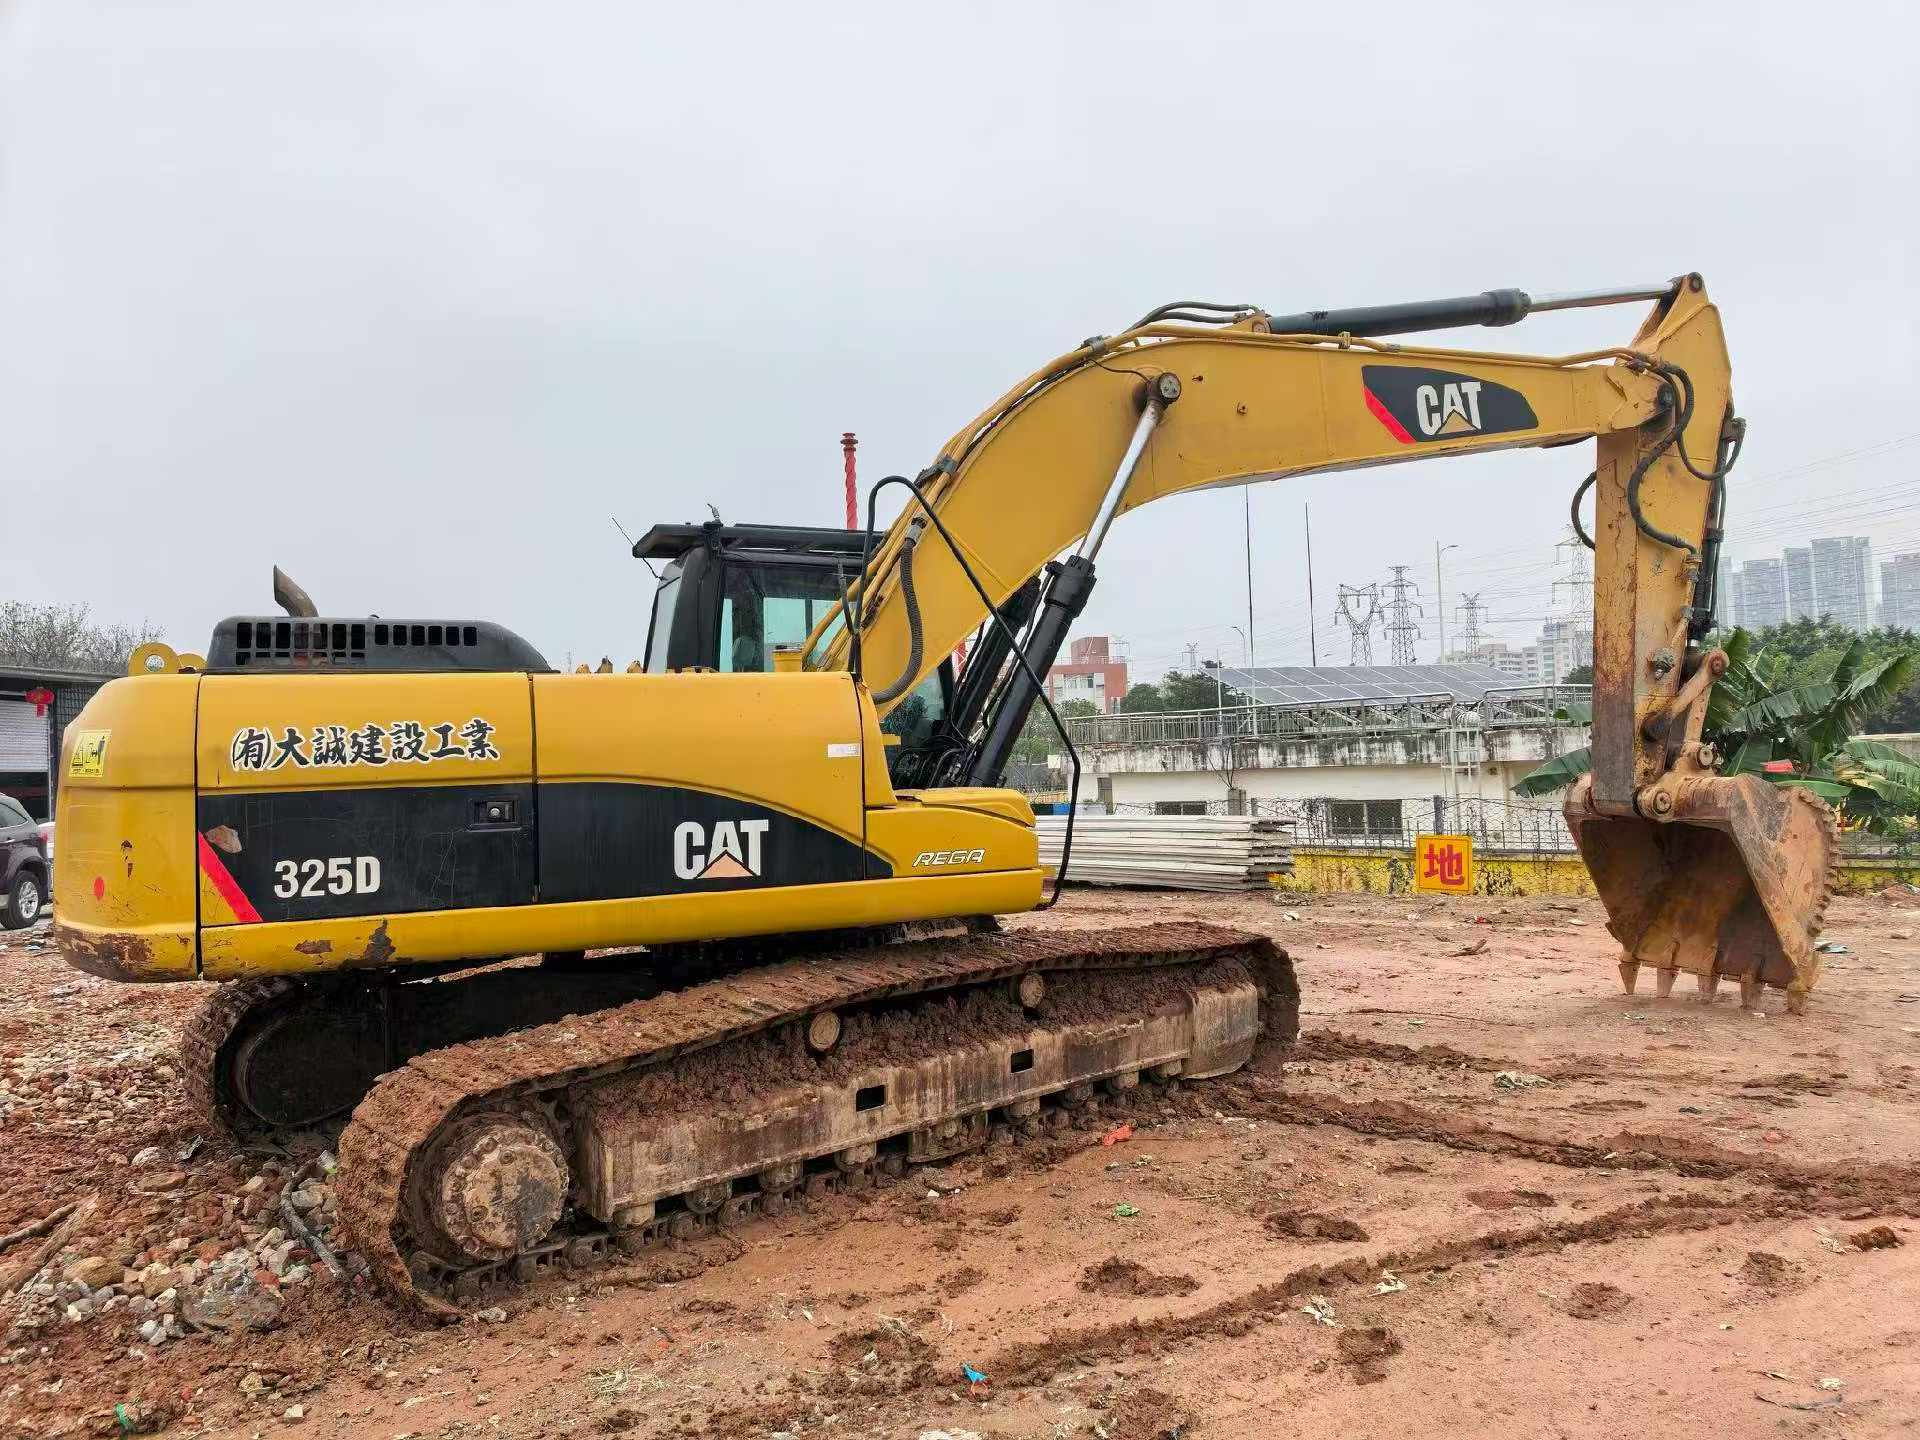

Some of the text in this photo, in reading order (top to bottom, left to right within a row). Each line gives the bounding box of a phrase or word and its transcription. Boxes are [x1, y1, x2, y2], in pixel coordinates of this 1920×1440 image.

[1416, 381, 1482, 436] CAT
[674, 819, 769, 879] CAT
[912, 848, 986, 868] REGA
[1423, 843, 1465, 886] 地
[274, 856, 381, 899] 325D
